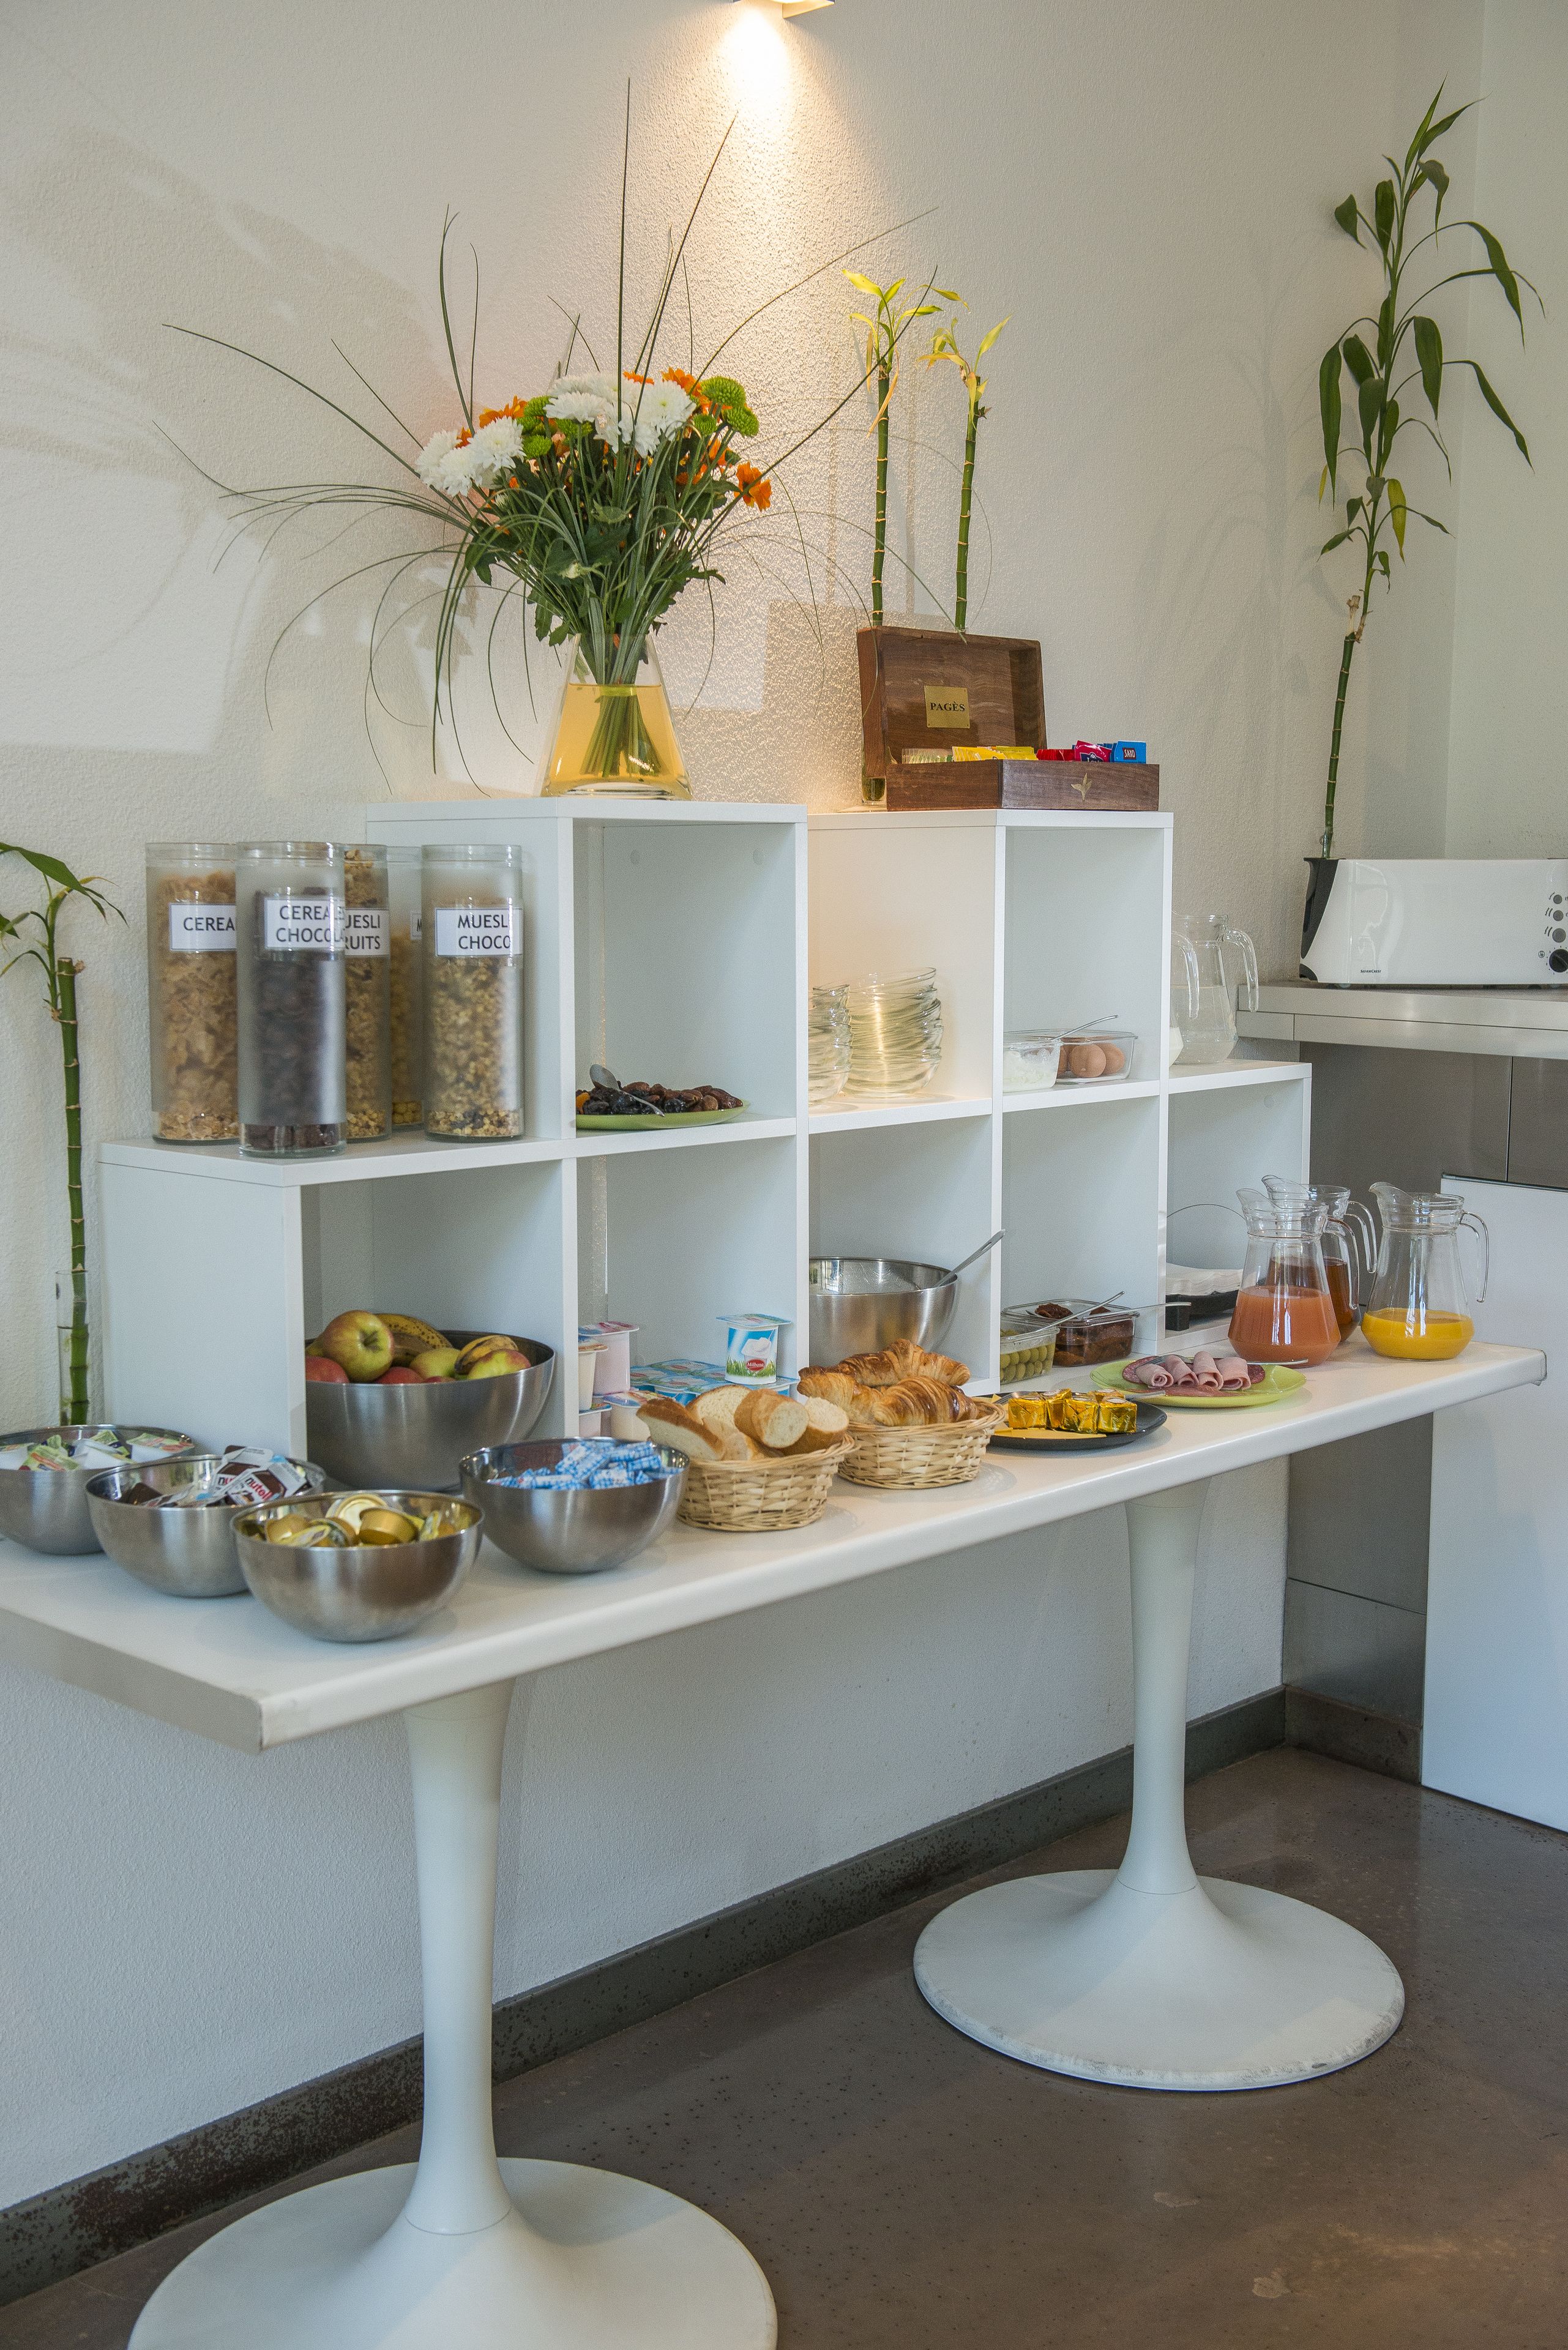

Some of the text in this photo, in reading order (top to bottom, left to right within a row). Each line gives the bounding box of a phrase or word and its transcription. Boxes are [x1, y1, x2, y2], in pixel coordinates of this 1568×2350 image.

[930, 701, 965, 712] PAGÈS
[1124, 749, 1135, 758] SAXO
[183, 917, 235, 931] CEREA
[345, 914, 381, 929] UESLI
[458, 914, 510, 928] MUESL
[345, 936, 381, 950] RUITS
[458, 935, 511, 949] CHOCO
[245, 1477, 273, 1501] nutell
